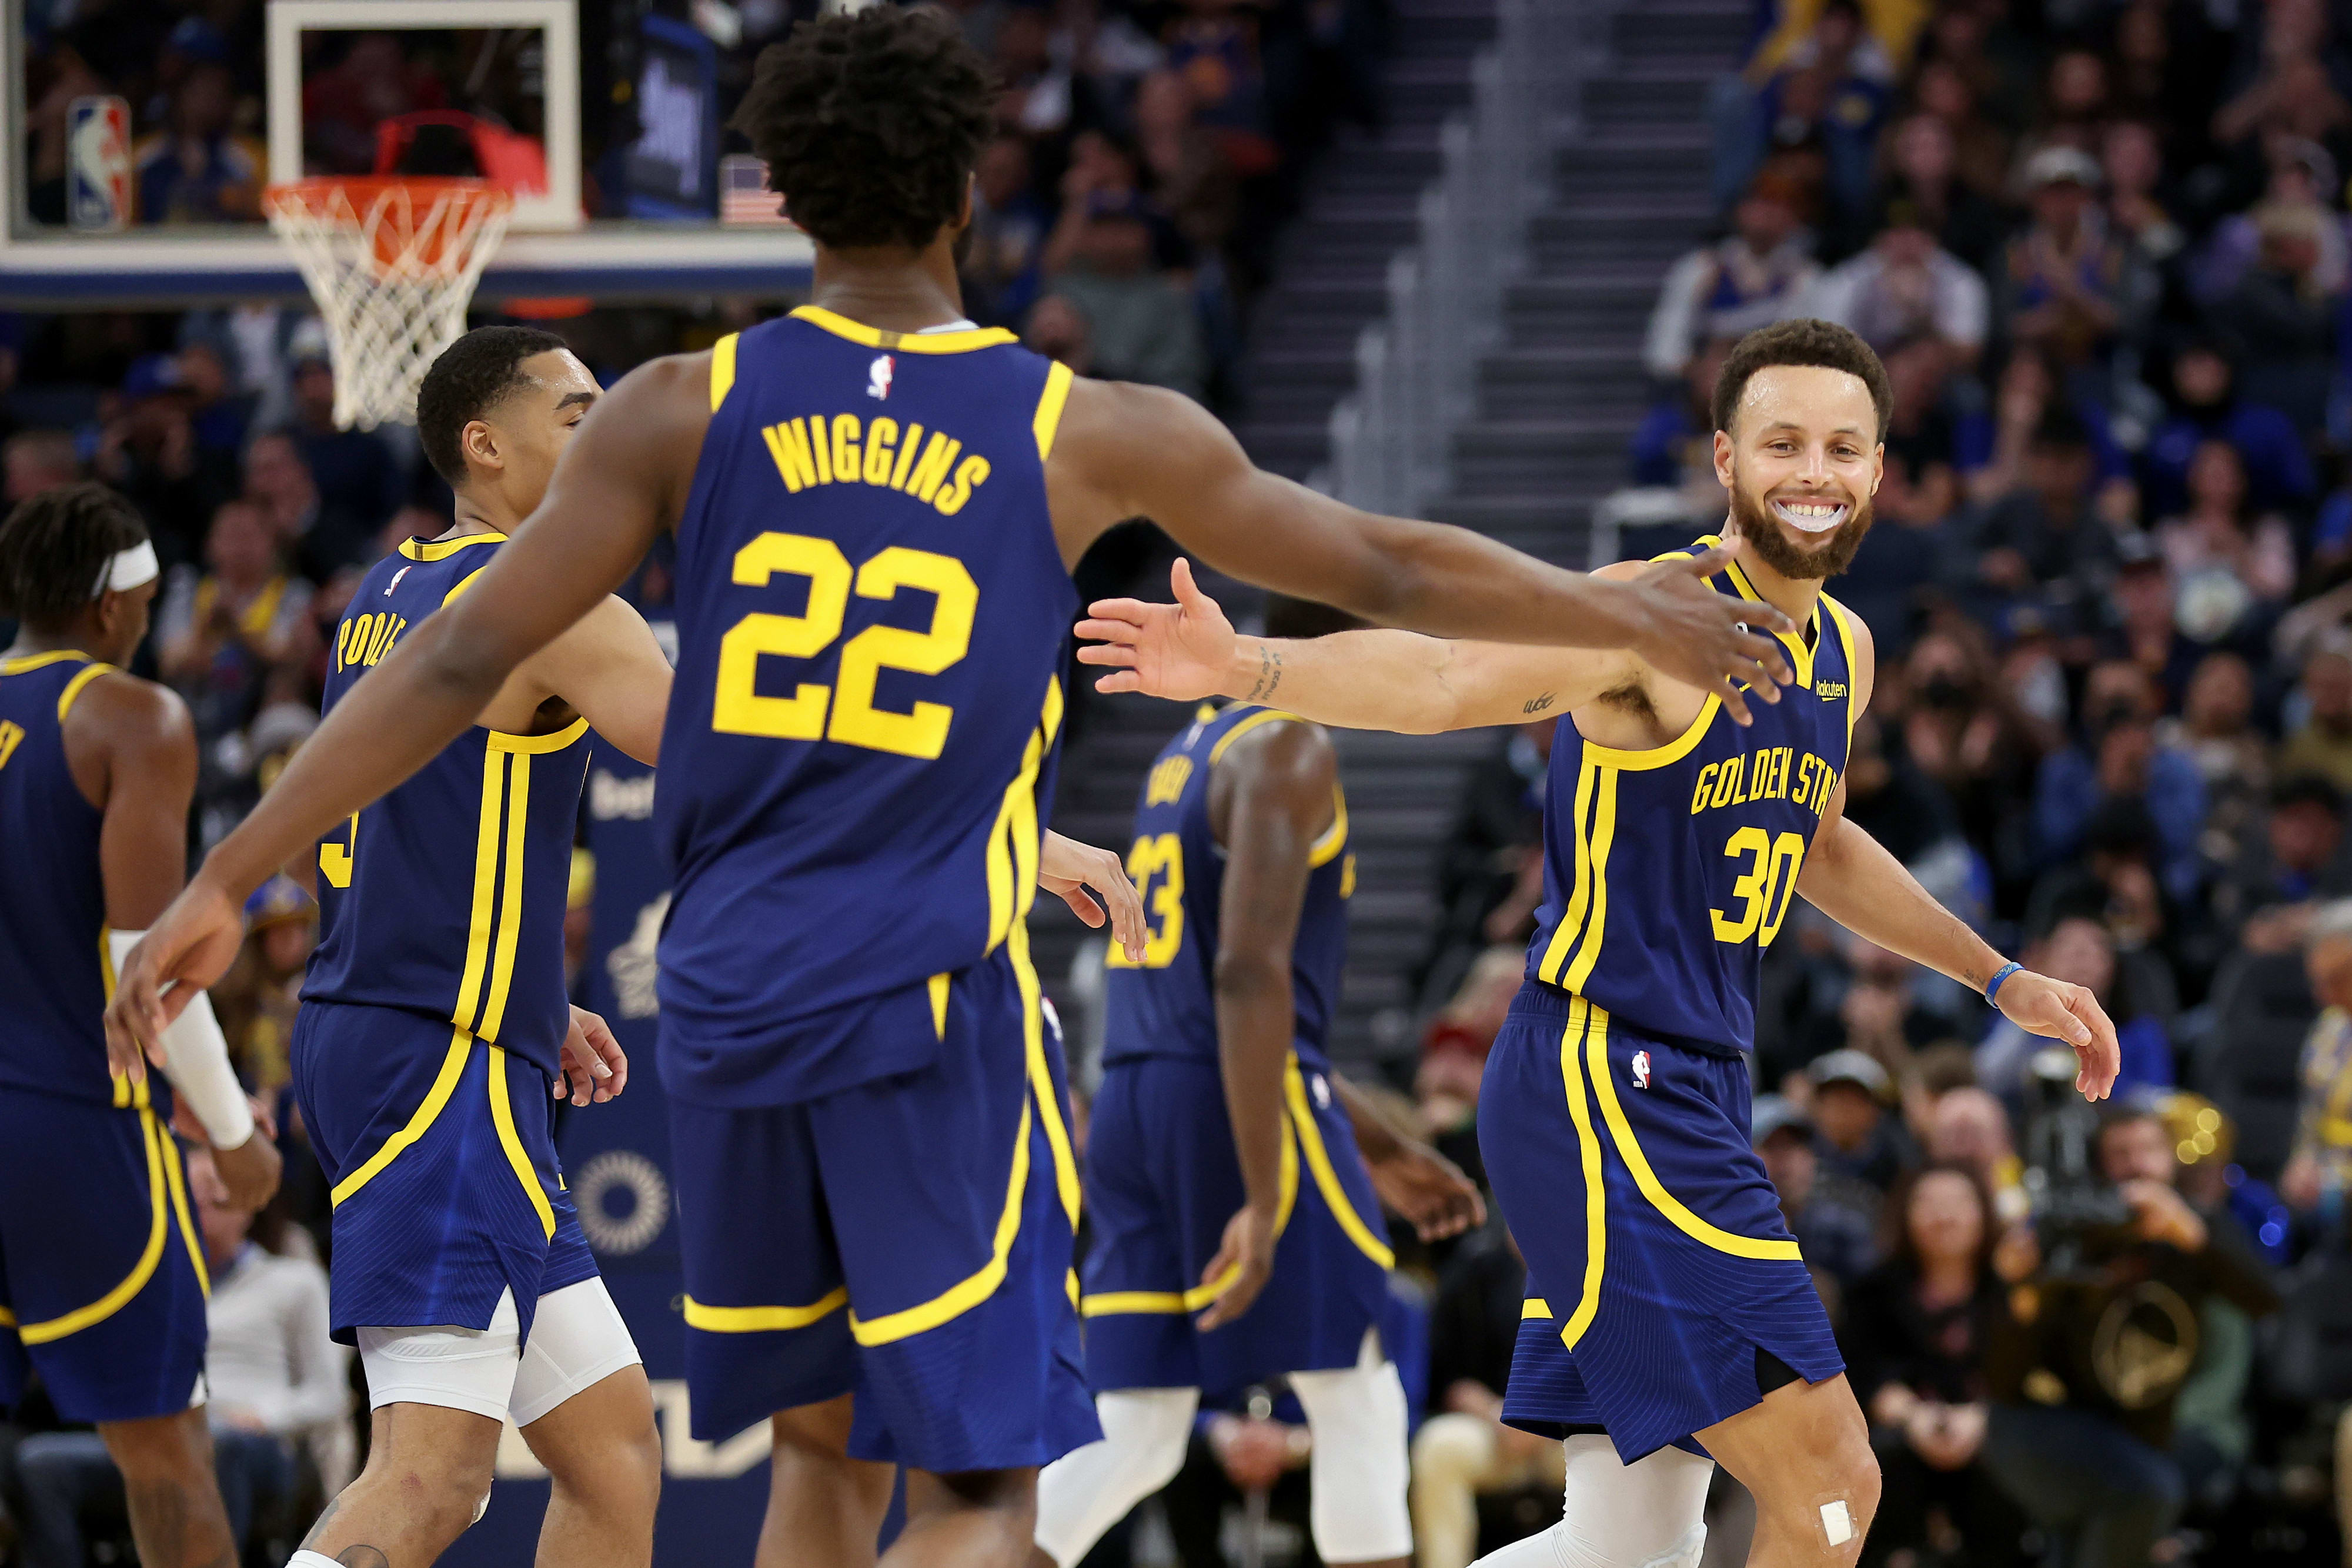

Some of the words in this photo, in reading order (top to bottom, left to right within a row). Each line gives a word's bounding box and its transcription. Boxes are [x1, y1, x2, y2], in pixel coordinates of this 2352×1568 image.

[761, 412, 991, 516] WIGGINS
[337, 612, 407, 674] POOLE
[712, 530, 980, 760] 22
[1816, 678, 1847, 697] Rakuten
[1690, 747, 1793, 815] GOLDEN
[1709, 826, 1805, 947] 30
